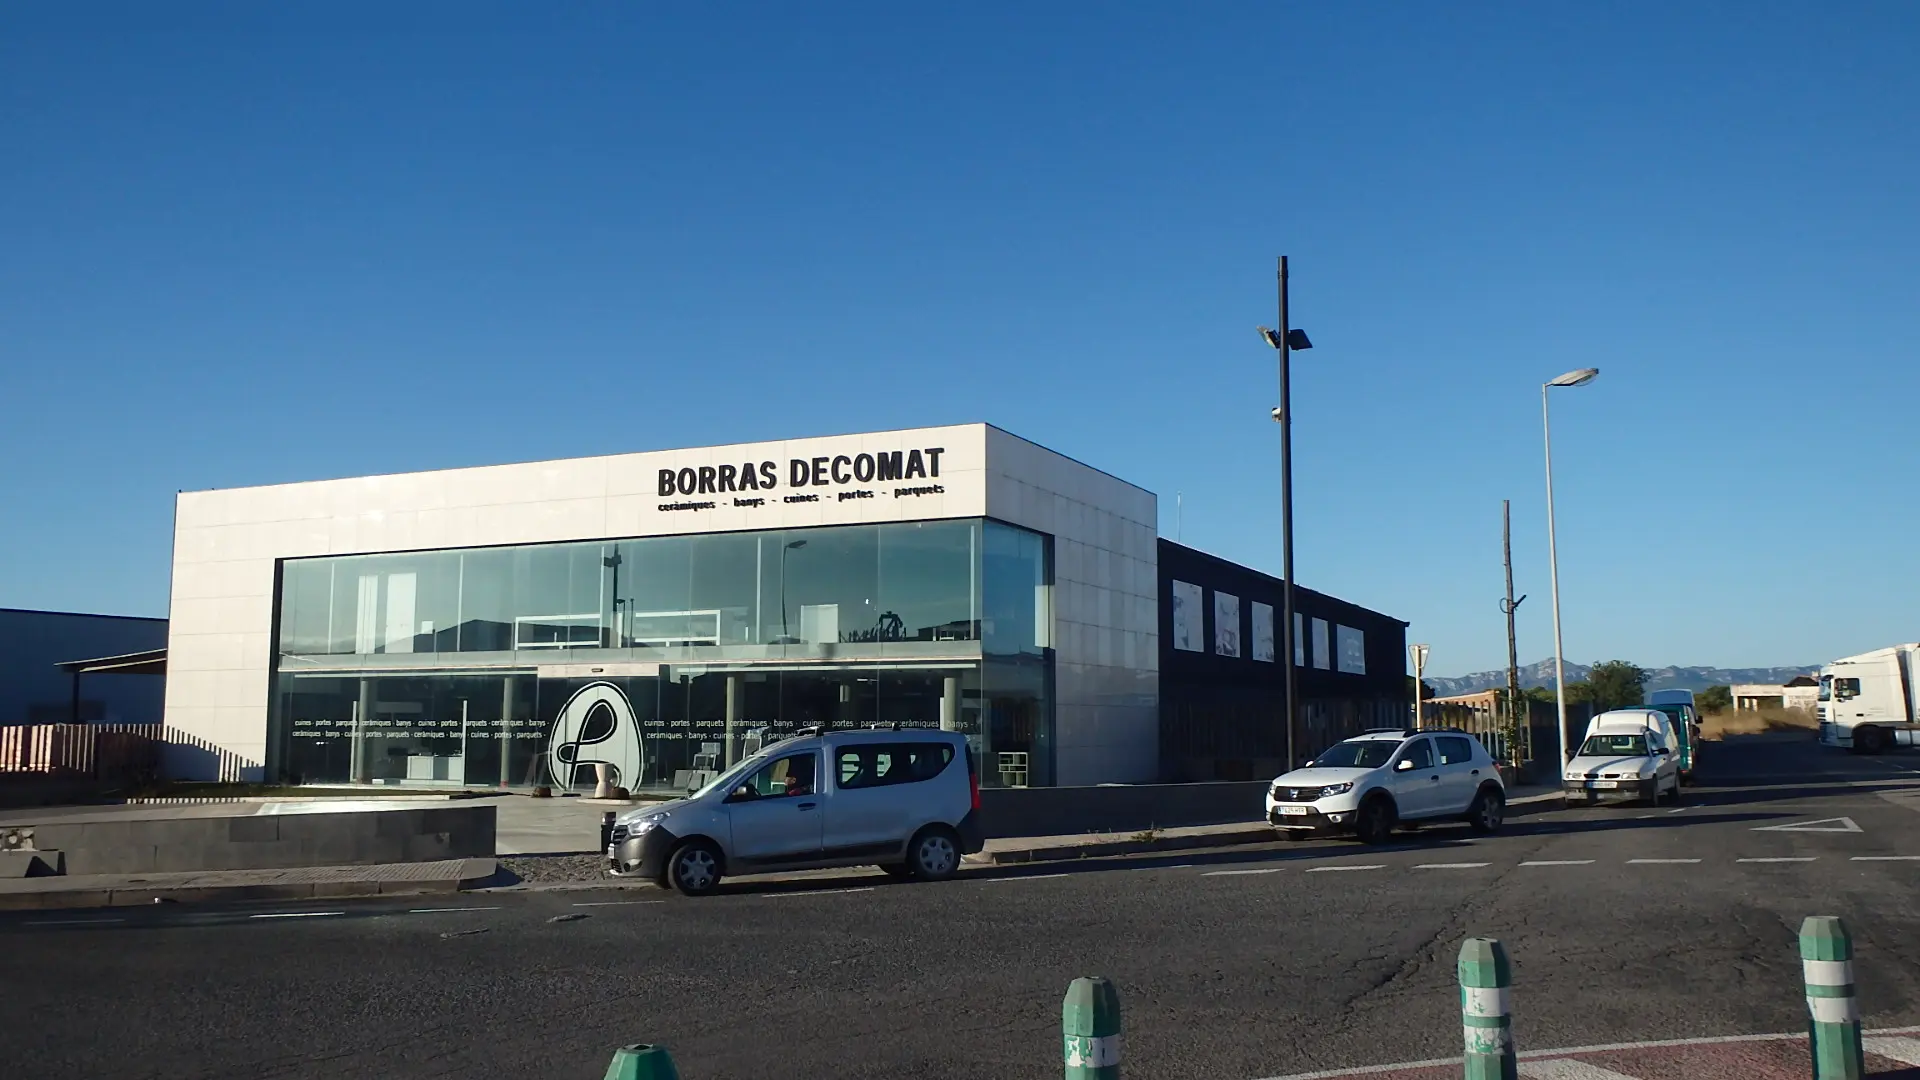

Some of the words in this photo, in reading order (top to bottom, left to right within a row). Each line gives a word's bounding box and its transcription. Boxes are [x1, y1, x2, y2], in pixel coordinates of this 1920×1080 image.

[658, 461, 777, 496] BORRAS
[790, 447, 945, 487] DECOMAT
[733, 497, 765, 508] banys
[838, 489, 874, 502] portes
[894, 484, 945, 498] parquets
[671, 719, 690, 728] portes
[696, 719, 724, 728] parquets
[774, 719, 793, 728] banys
[832, 719, 854, 728] portes
[471, 730, 489, 738] cuines
[688, 731, 707, 741] banys
